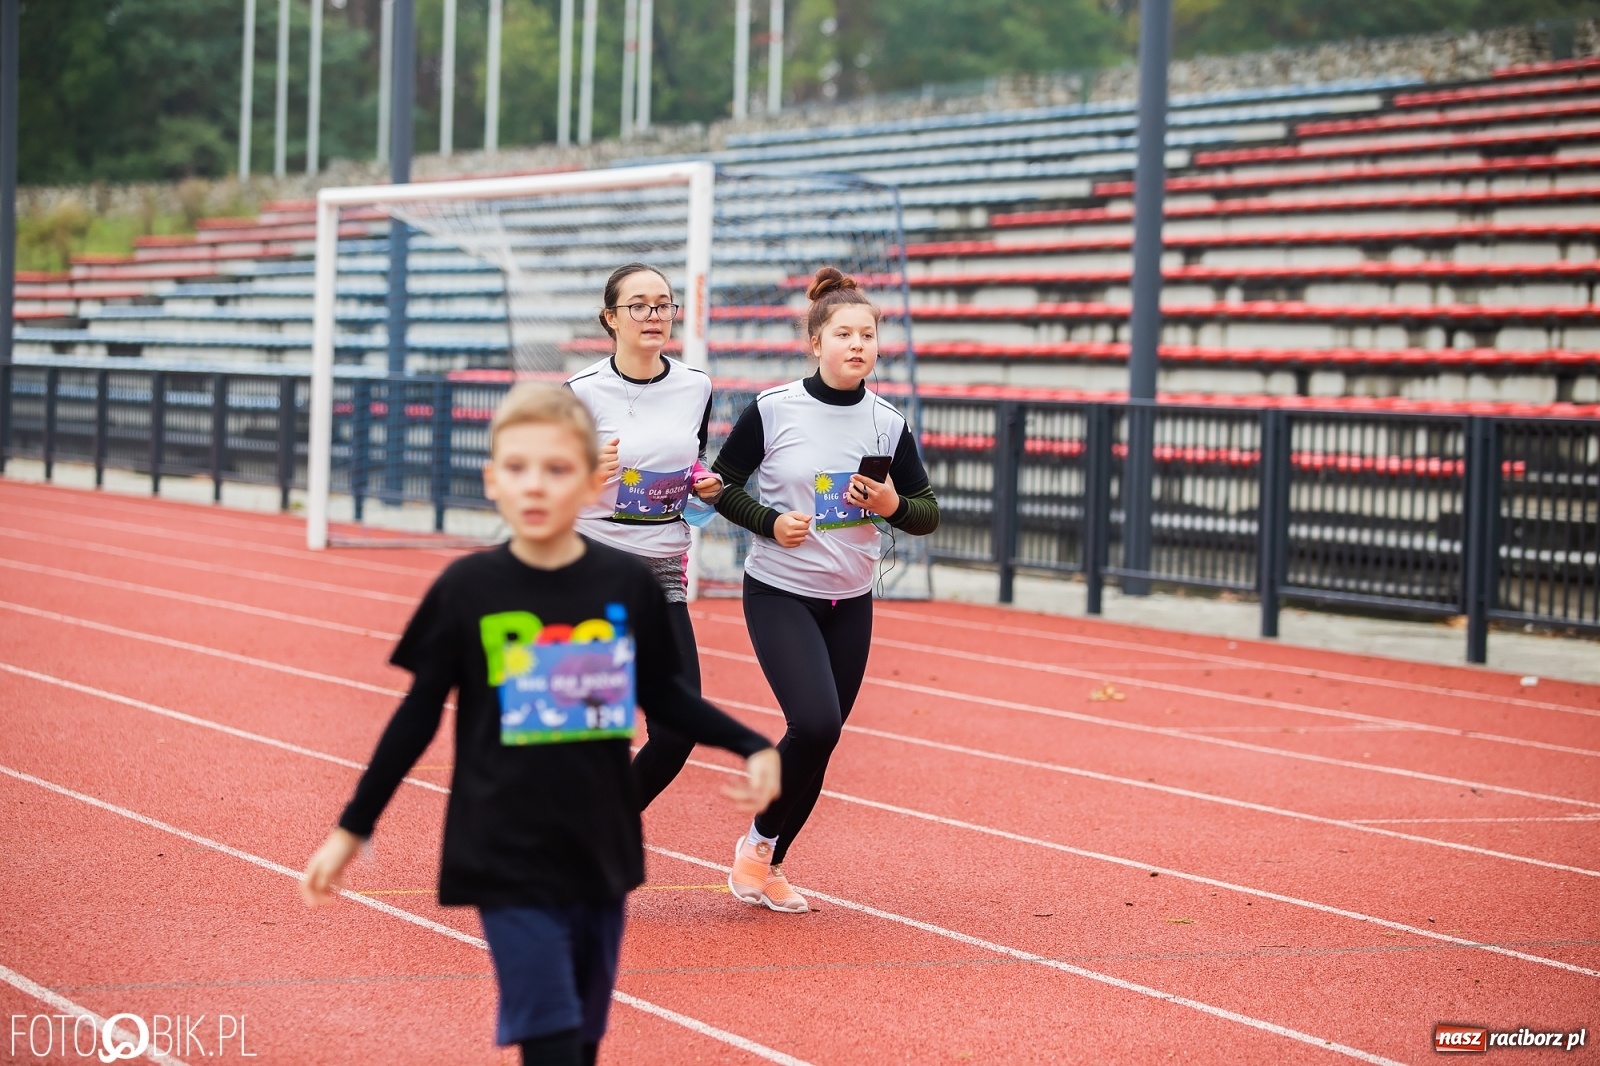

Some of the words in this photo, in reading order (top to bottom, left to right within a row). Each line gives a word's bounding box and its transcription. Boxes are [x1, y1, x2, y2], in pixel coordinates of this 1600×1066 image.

[629, 486, 645, 495] BIEG
[823, 492, 839, 501] BIEG
[661, 499, 682, 514] 326
